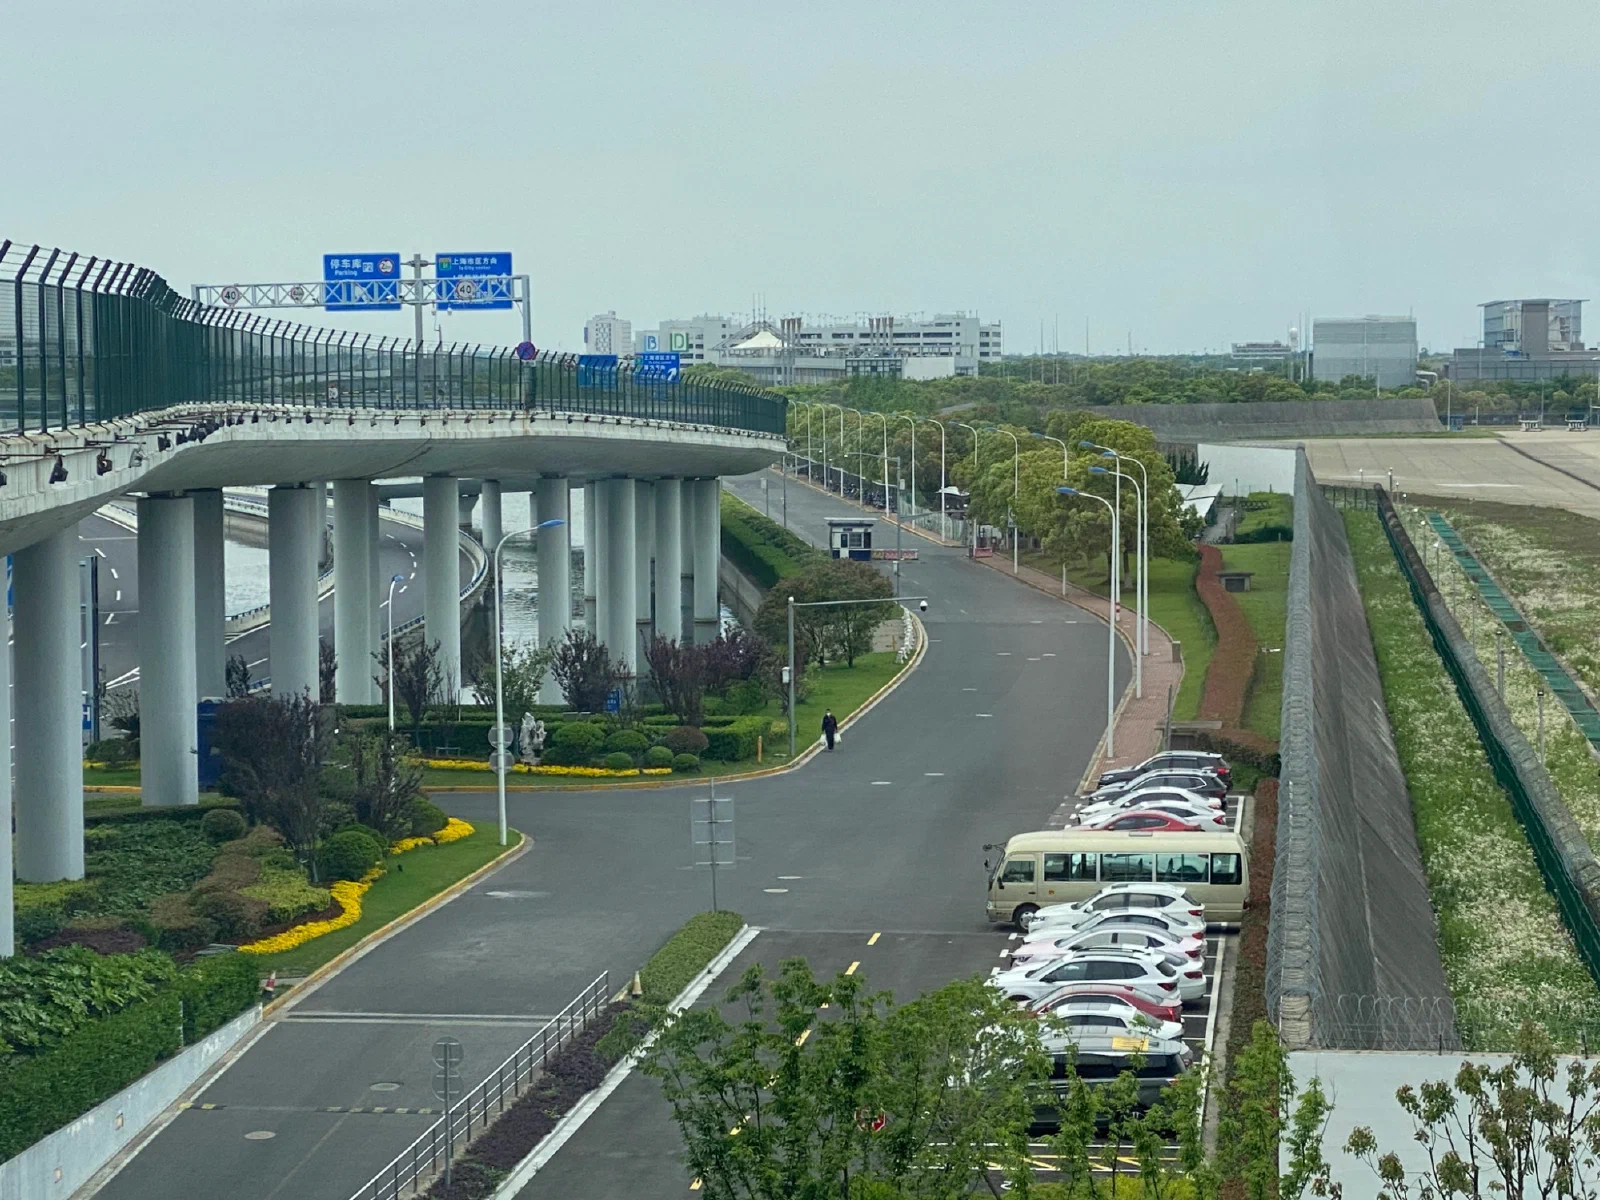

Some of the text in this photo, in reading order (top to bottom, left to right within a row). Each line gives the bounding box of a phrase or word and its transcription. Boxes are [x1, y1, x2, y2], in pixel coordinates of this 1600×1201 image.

[330, 258, 362, 269] 停车库
[334, 269, 358, 277] Parking
[459, 285, 472, 294] 40
[224, 290, 236, 300] 40
[647, 335, 657, 350] B
